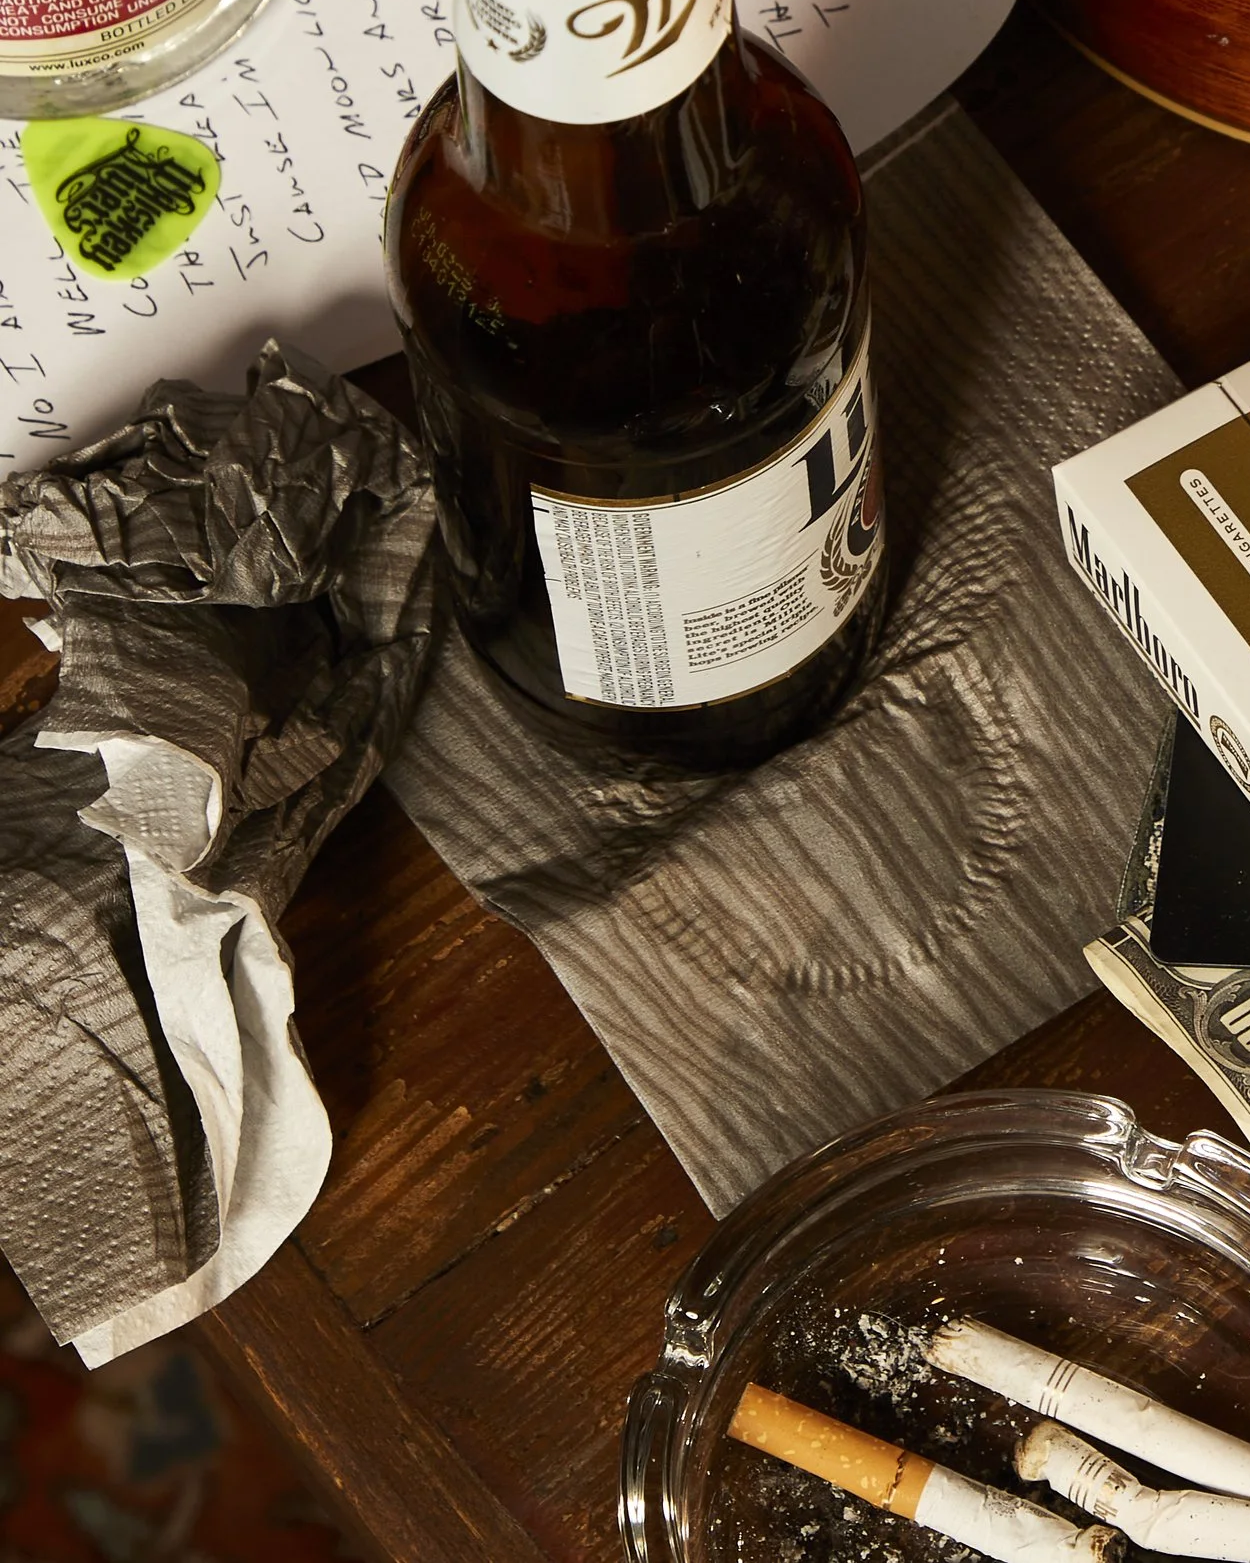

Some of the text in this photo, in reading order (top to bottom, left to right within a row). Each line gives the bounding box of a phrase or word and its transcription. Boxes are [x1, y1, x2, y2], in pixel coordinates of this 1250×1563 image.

[0, 11, 120, 37] CONSUMPTION
[42, 0, 123, 24] CONSUME
[100, 1, 176, 42] BOTTLED
[29, 41, 145, 72] www.luxco.com
[381, 63, 422, 119] ARS
[221, 58, 325, 243] CAUSE I'M
[216, 193, 269, 280] JUST
[49, 235, 106, 336] WELL
[18, 397, 71, 440] NO
[684, 577, 805, 632] beer, brewed with
[684, 612, 722, 625] Inside
[748, 592, 771, 606] fine
[685, 584, 805, 639] the highest quality
[686, 592, 805, 646] ingredients. Our
[687, 636, 738, 653] secret
[764, 598, 808, 628] Miller
[688, 602, 812, 660] Lite's special triple
[1065, 500, 1201, 719] Marlboro
[689, 606, 818, 667] hops brewing recipe.
